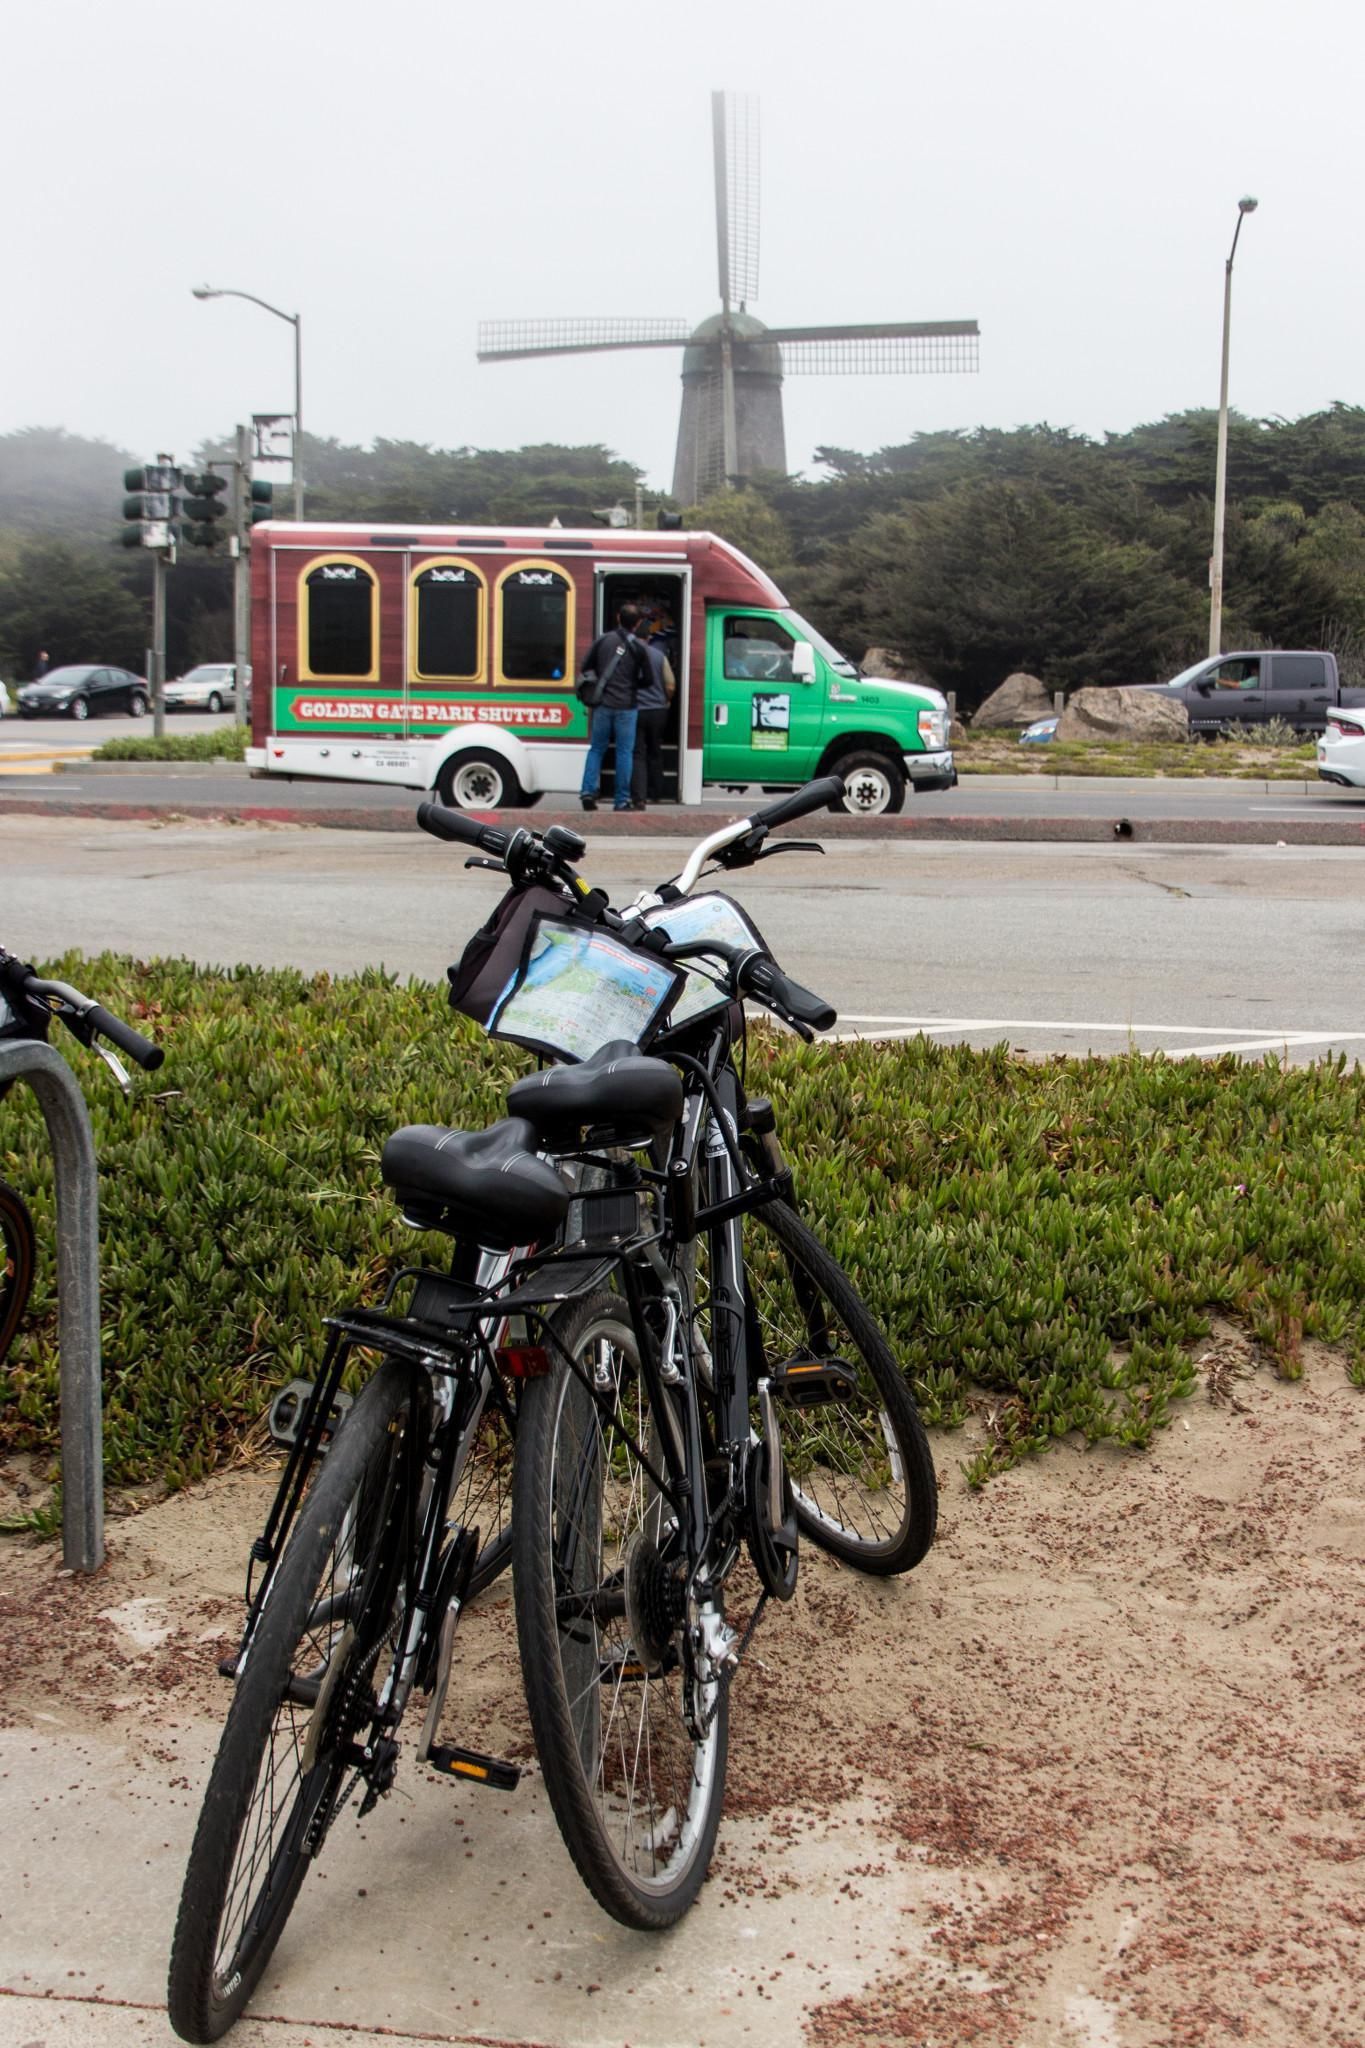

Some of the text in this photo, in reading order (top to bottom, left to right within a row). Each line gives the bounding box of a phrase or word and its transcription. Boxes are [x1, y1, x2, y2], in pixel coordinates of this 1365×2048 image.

[300, 702, 561, 723] GOLDEN GATE PARK SHUTTLE
